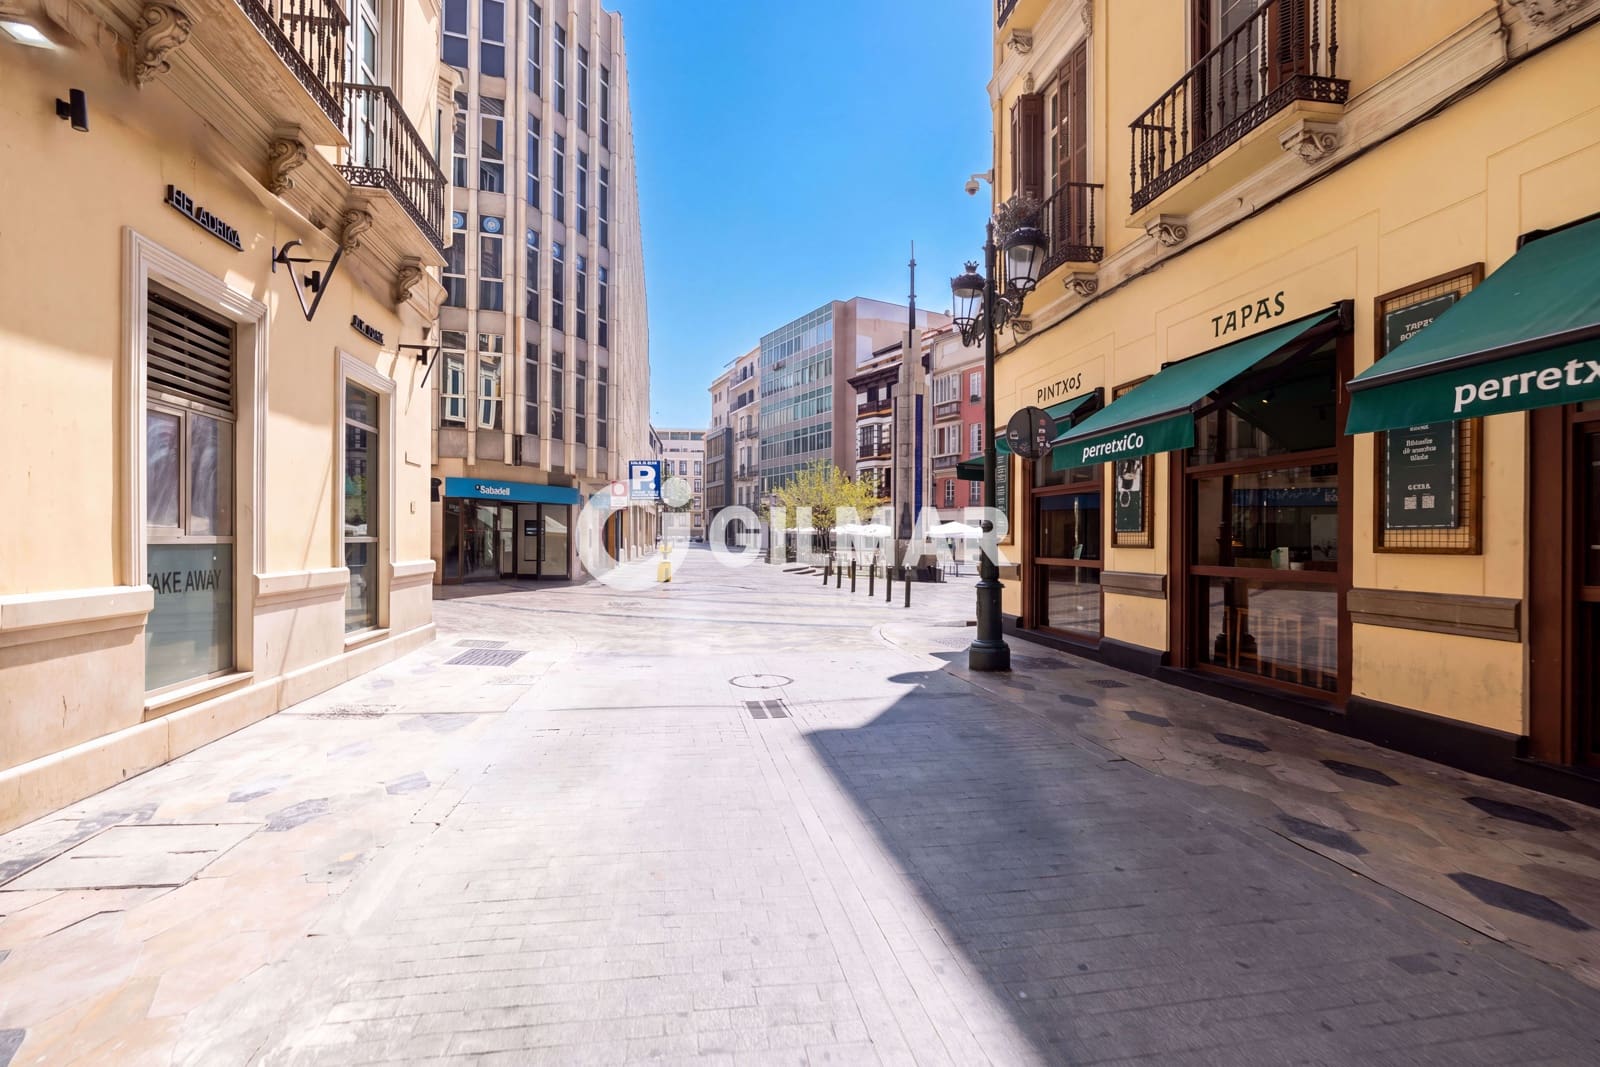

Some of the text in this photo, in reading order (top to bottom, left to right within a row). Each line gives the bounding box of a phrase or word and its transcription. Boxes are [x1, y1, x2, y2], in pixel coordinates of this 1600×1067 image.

[1211, 290, 1285, 338] TAPAS
[480, 485, 510, 496] Sabadell
[185, 568, 222, 592] AWAY
